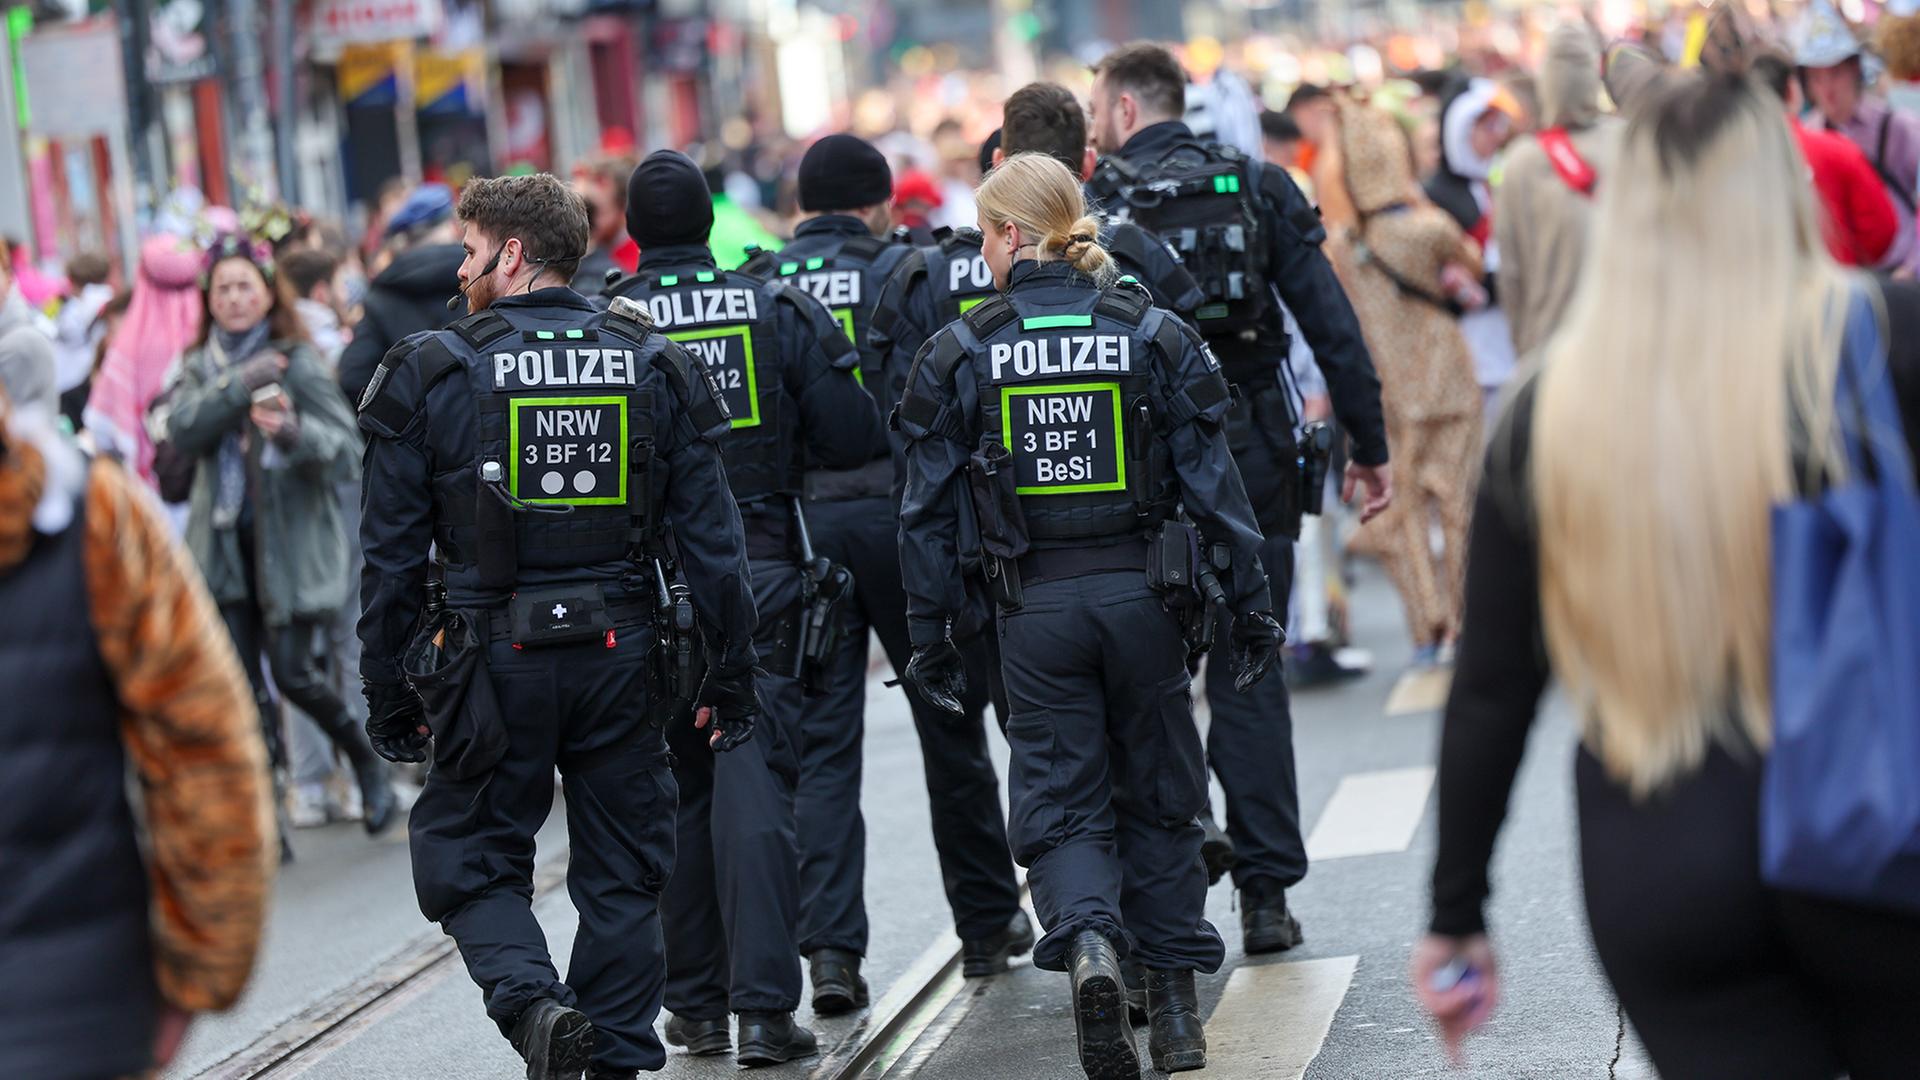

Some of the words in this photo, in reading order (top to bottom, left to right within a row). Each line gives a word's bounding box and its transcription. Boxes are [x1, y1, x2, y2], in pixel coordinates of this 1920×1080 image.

[493, 349, 636, 387] POLIZEI
[990, 335, 1130, 379] POLIZEI
[536, 409, 601, 437] NRW
[1027, 396, 1093, 425] NRW
[525, 444, 538, 464] 3
[546, 443, 578, 464] BF
[586, 442, 612, 463] 12
[1023, 432, 1037, 453] 3
[1045, 430, 1077, 451] BF
[1086, 429, 1097, 449] 1
[1036, 455, 1092, 482] BeSi
